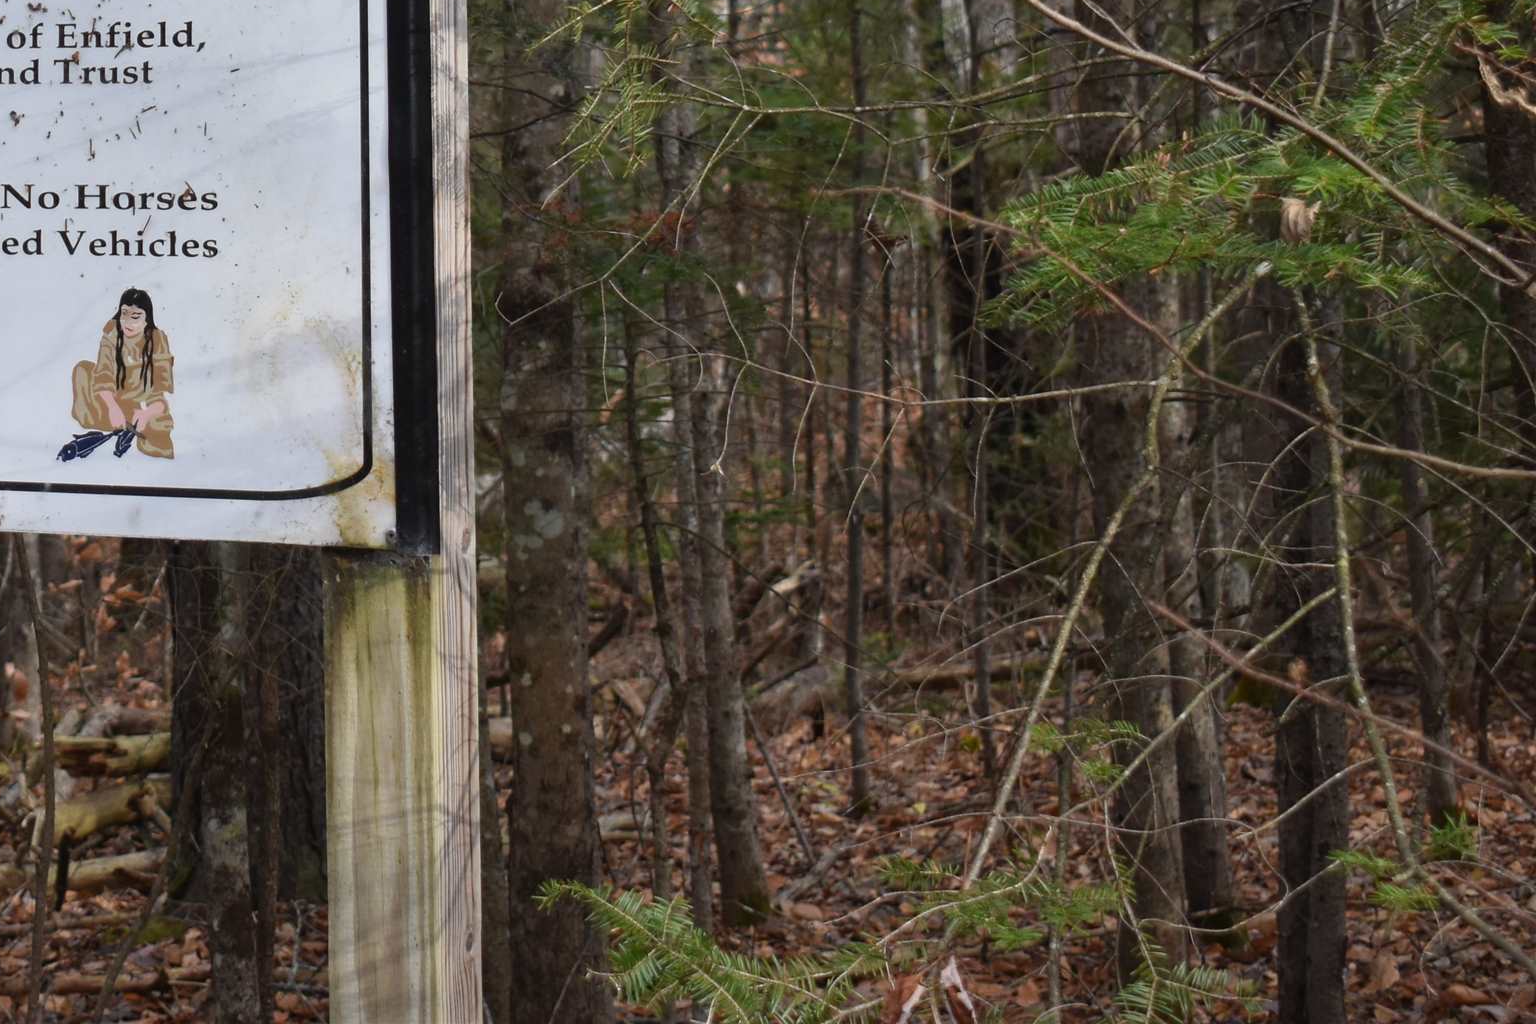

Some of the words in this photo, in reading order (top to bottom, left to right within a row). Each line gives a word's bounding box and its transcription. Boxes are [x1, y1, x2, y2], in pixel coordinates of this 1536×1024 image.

[7, 23, 43, 49] of
[56, 21, 205, 53] Enfield,
[54, 57, 152, 84] Trust
[75, 183, 218, 211] Horses
[57, 228, 218, 258] Vehicles
